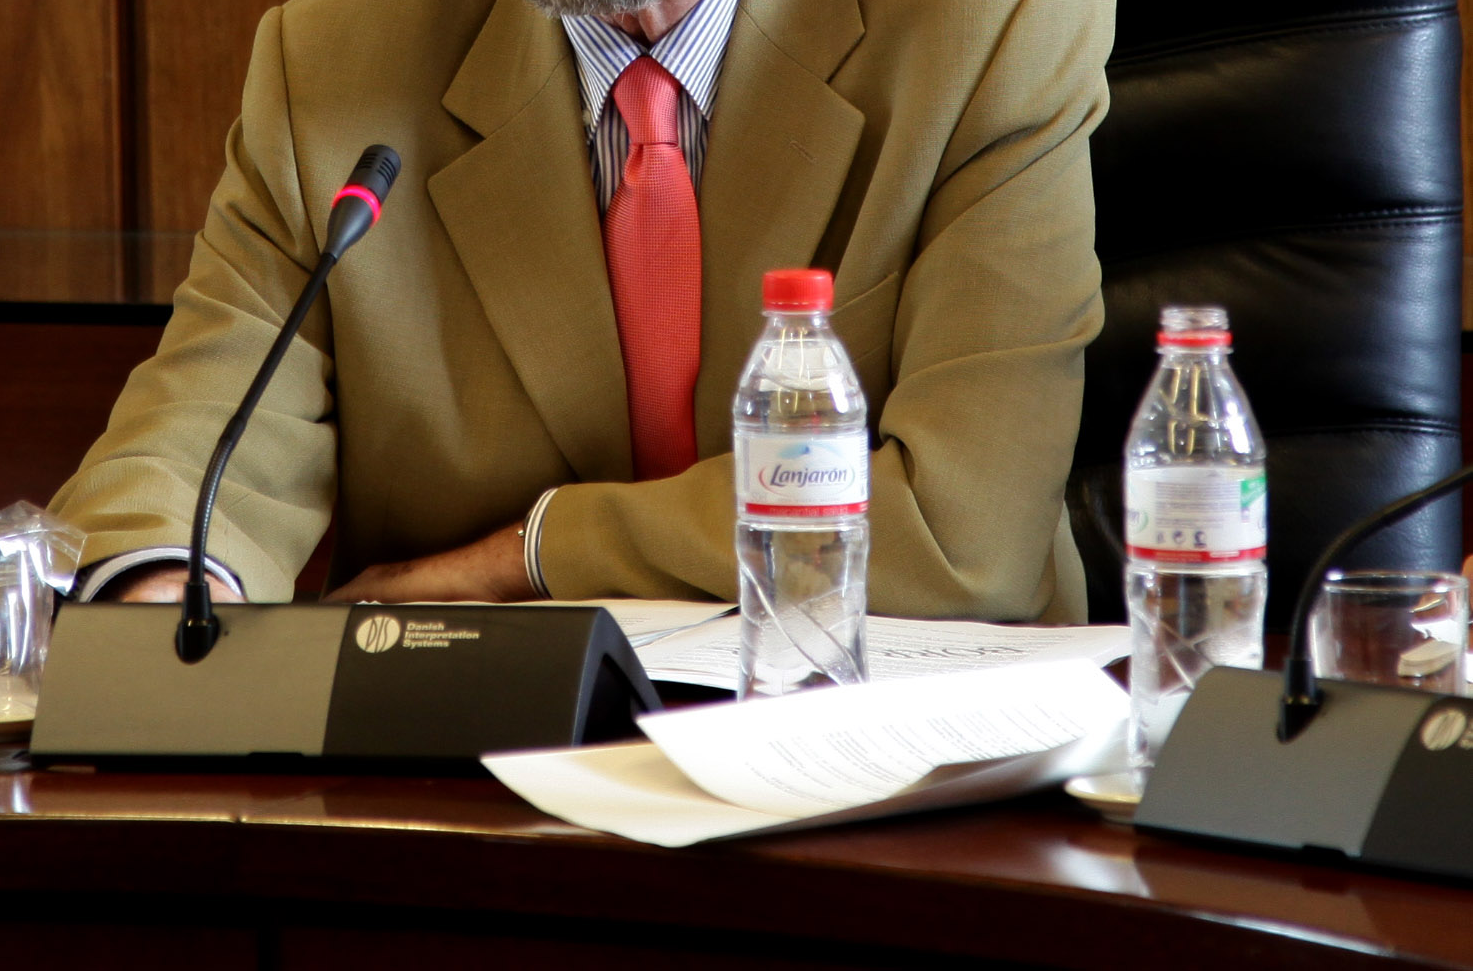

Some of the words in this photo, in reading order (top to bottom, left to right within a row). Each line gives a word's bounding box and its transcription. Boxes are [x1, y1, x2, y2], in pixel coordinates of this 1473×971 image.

[770, 464, 847, 488] Lanjarón
[406, 622, 445, 631] Danish
[404, 631, 480, 642] Interpretation
[402, 640, 449, 649] Systems
